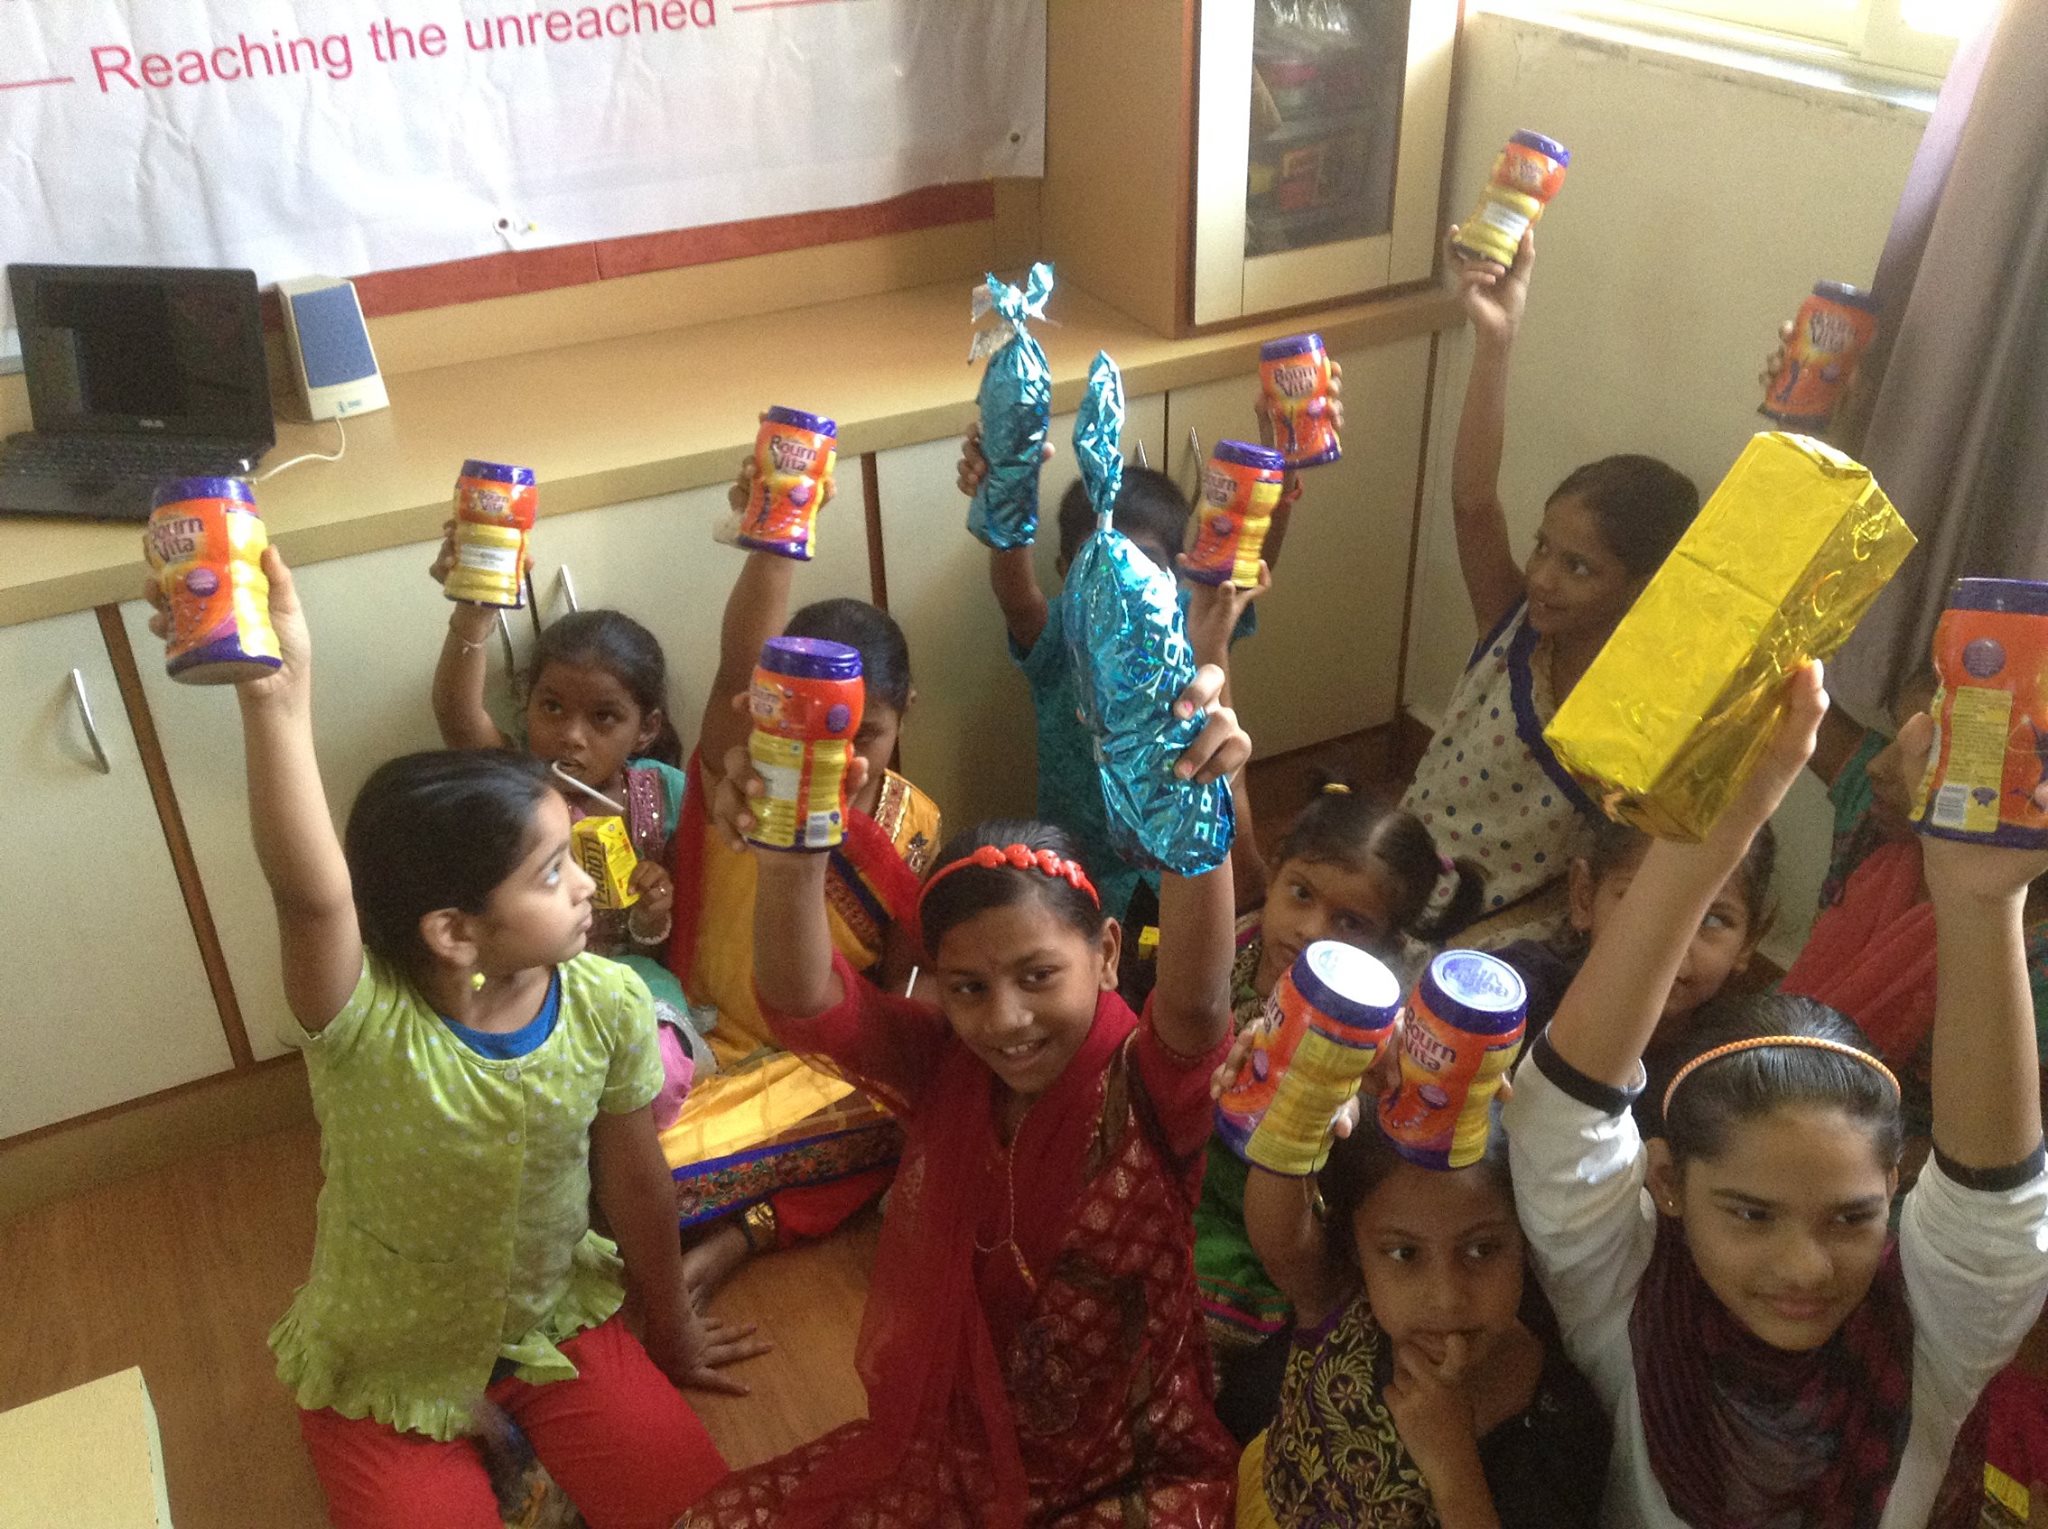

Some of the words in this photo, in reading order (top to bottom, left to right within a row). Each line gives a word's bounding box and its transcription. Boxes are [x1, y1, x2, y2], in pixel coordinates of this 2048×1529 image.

[90, 31, 354, 93] Reaching
[367, 17, 447, 63] the
[465, 0, 716, 51] unreached
[769, 435, 817, 461] Bourn
[1404, 1006, 1457, 1064] Bourn
[1405, 1029, 1441, 1071] Vita
